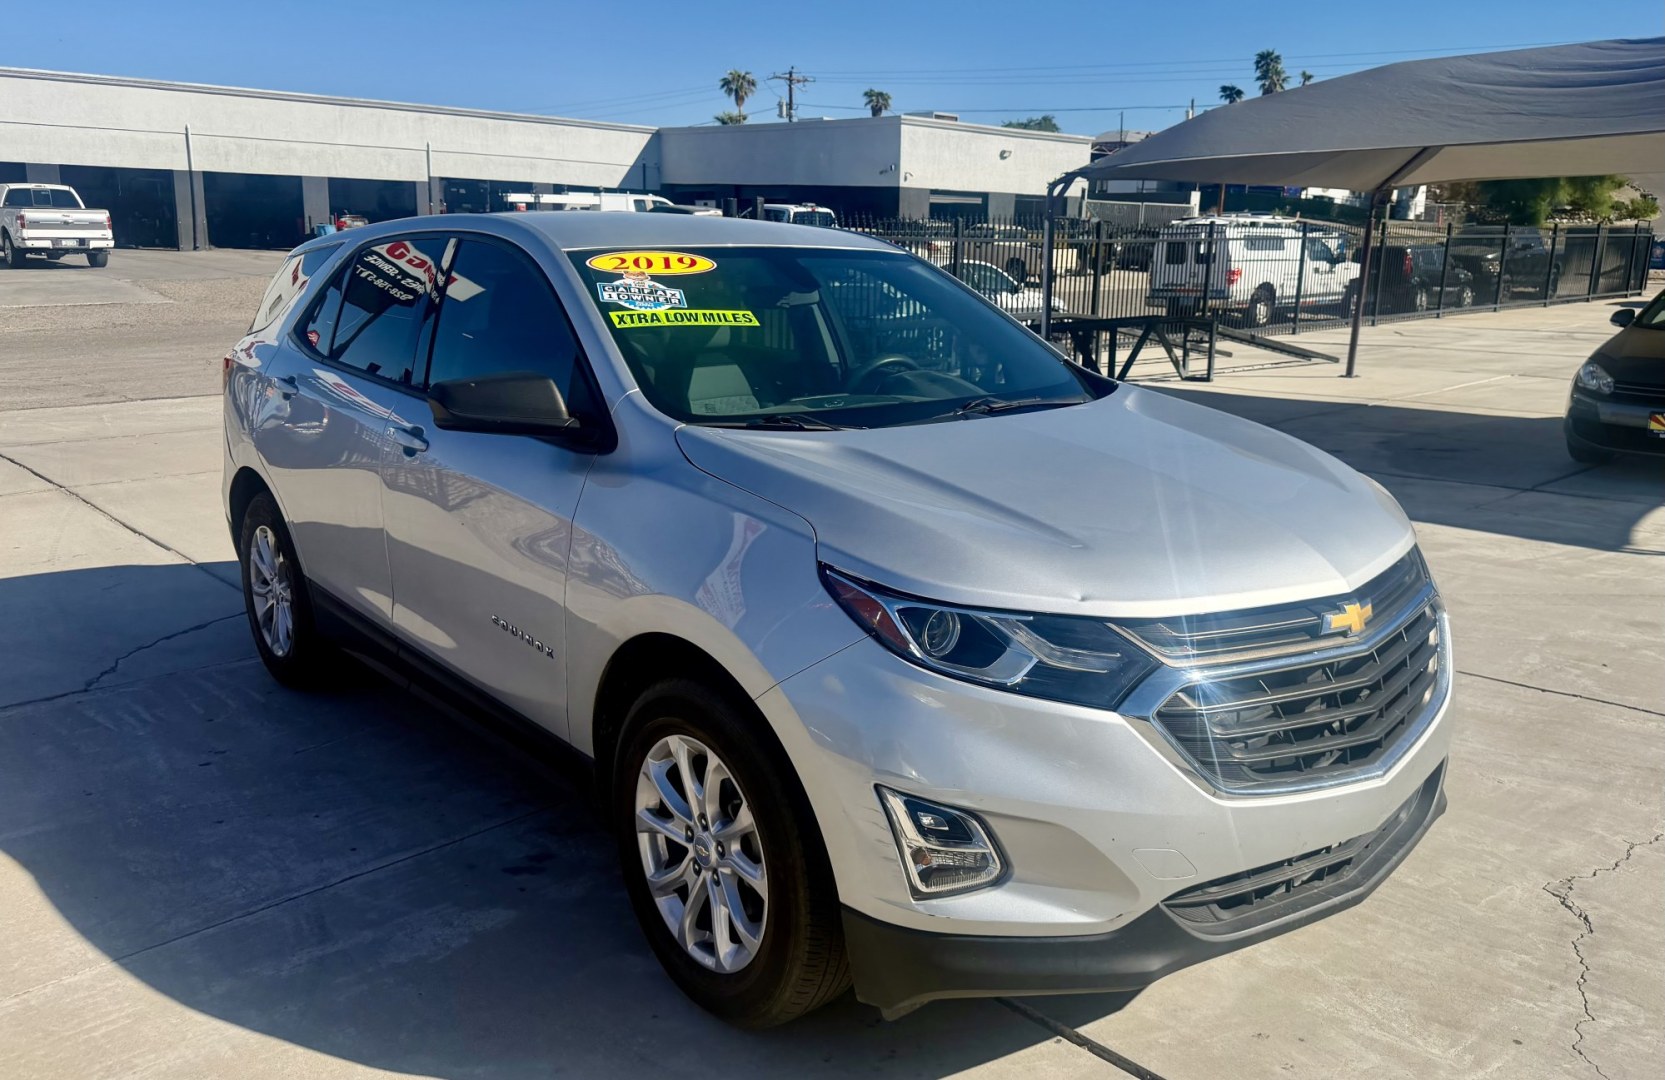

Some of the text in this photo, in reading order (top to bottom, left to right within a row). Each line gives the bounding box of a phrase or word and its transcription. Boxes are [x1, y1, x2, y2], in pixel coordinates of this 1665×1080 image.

[609, 256, 698, 270] 2019
[604, 285, 679, 298] CARFAX
[620, 293, 680, 305] OWNER
[615, 312, 754, 325] XTRA LOW MILES
